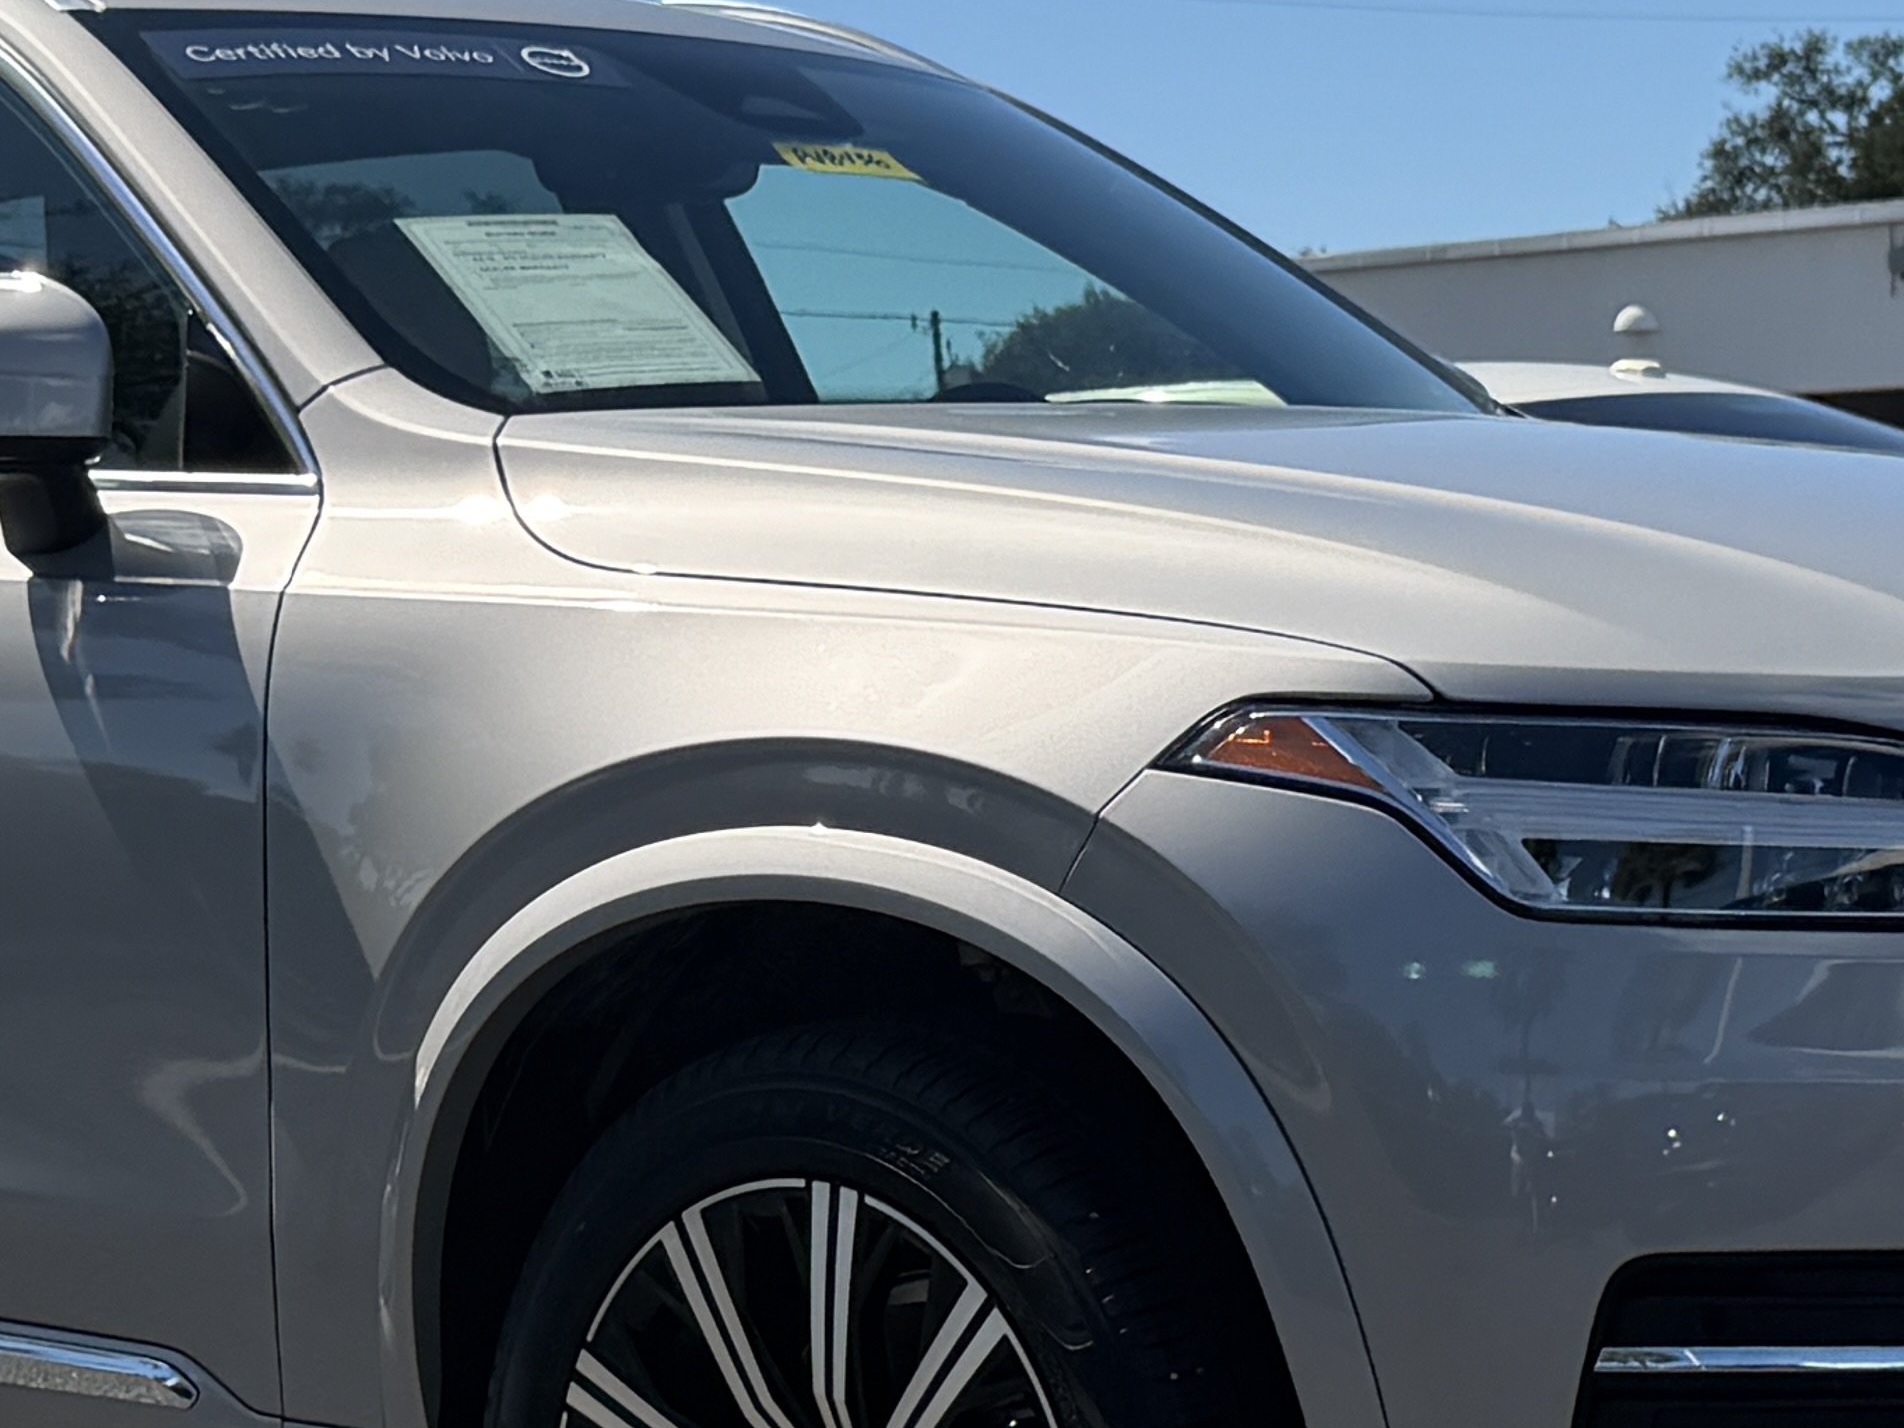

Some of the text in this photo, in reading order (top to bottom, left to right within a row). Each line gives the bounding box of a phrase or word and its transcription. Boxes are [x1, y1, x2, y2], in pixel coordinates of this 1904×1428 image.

[185, 42, 494, 64] Certified by Volvo
